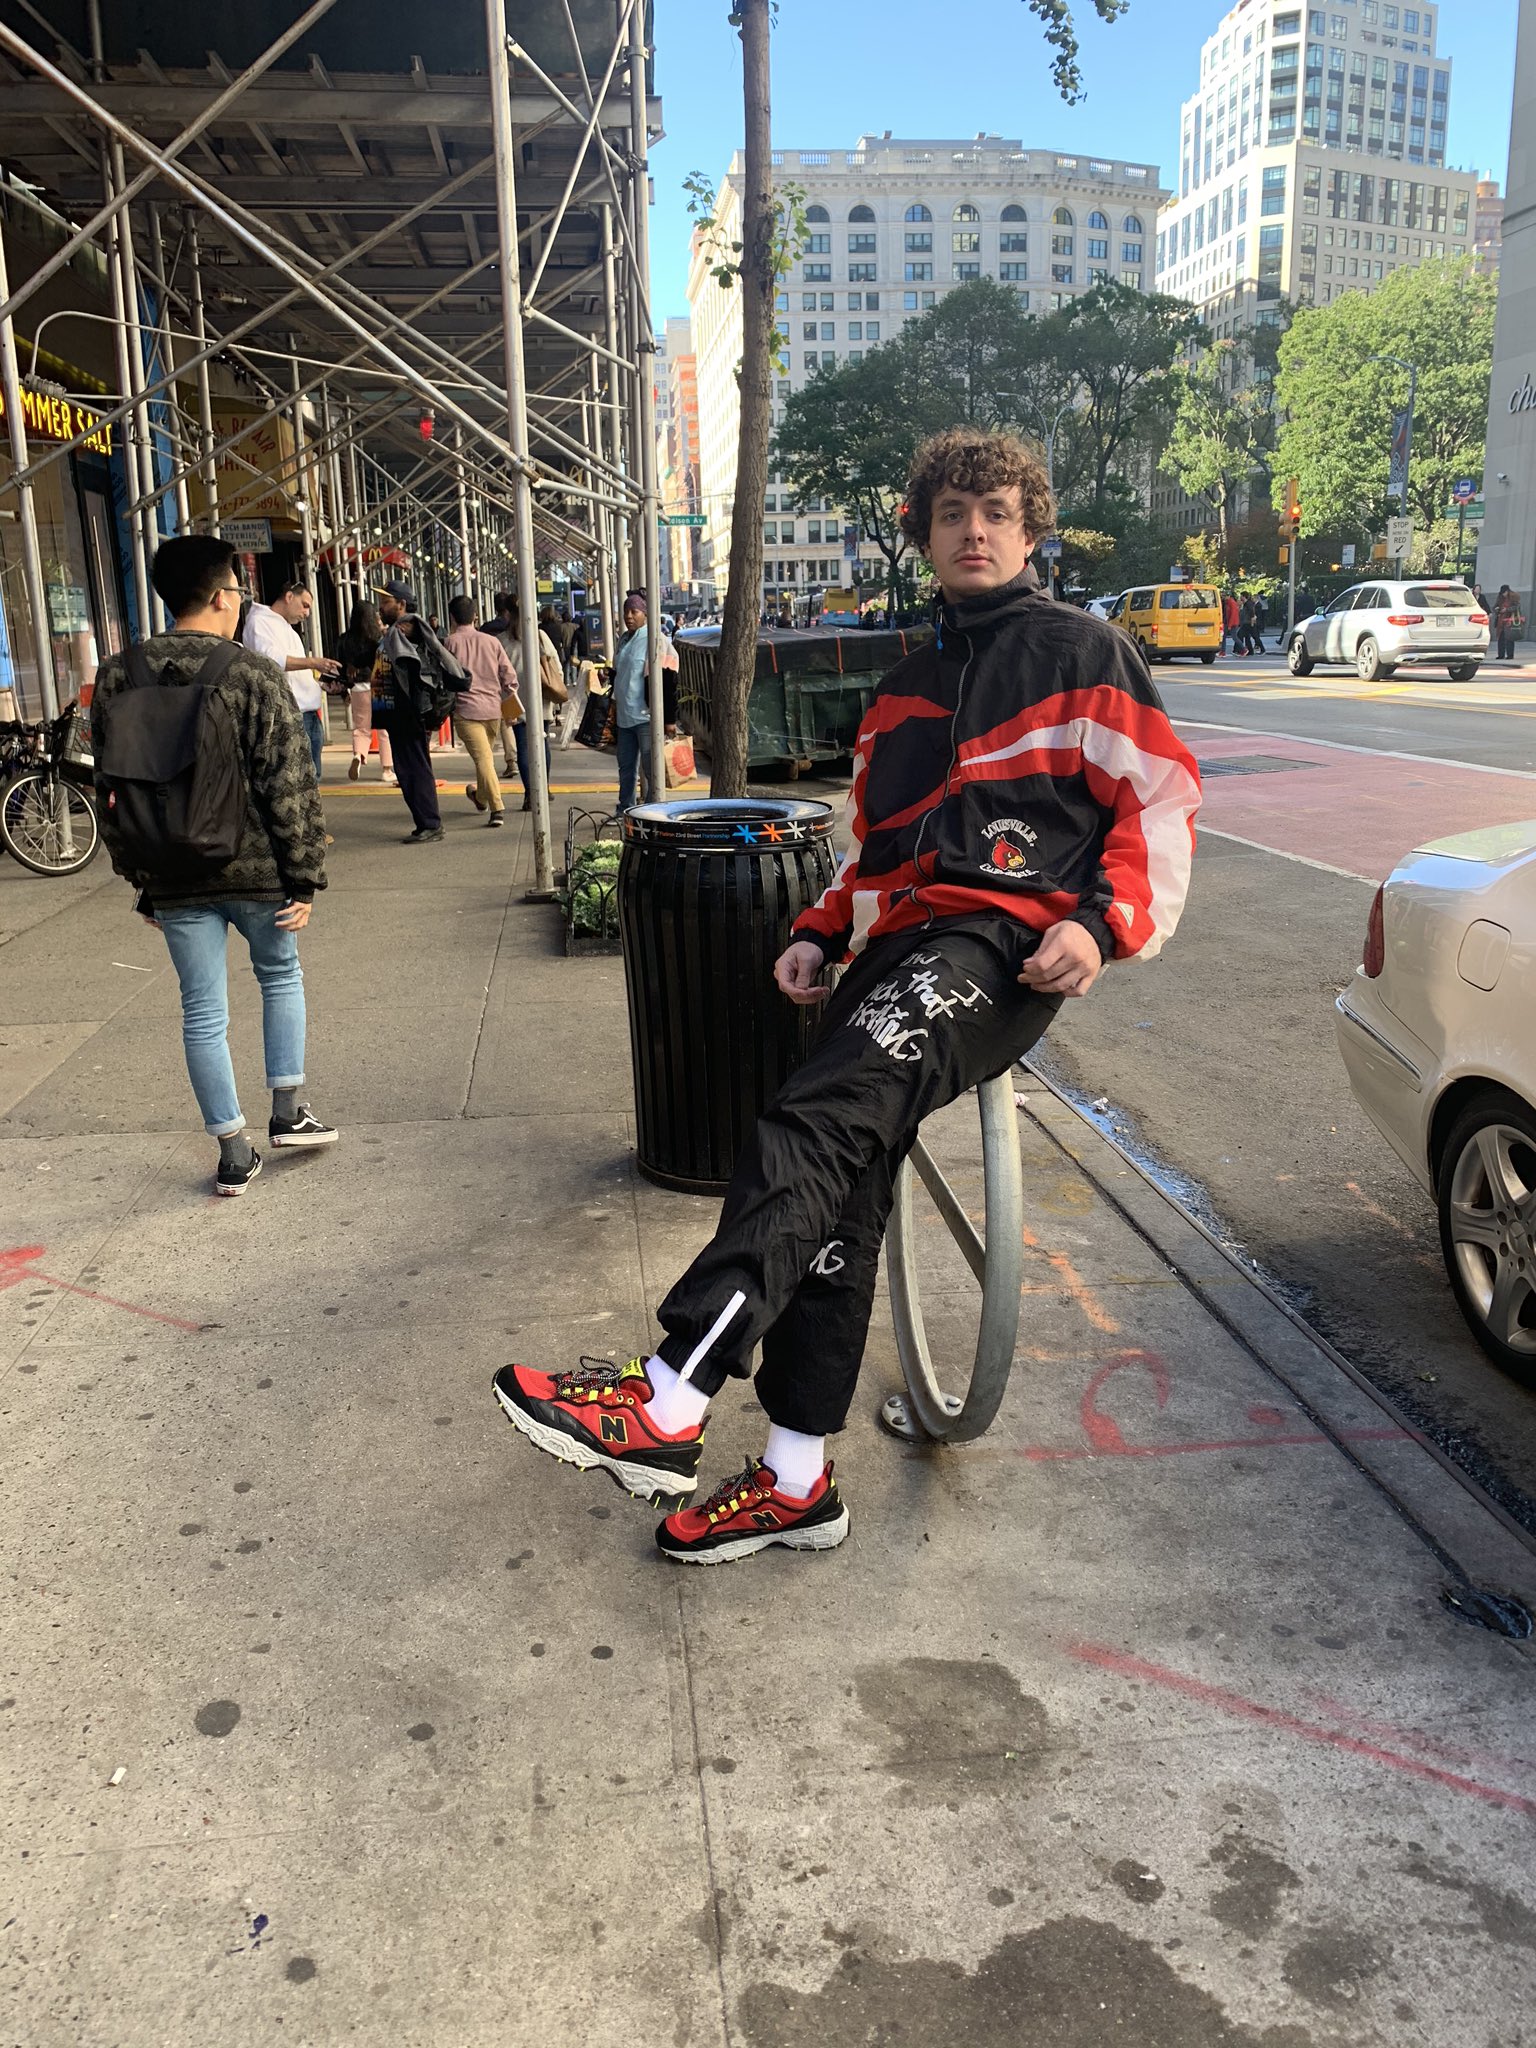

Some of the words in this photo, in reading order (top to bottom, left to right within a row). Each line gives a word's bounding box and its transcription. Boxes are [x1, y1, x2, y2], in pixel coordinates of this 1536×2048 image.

[0, 385, 73, 441] MMER
[661, 516, 690, 524] dison
[1393, 521, 1409, 529] STOP
[981, 818, 1038, 843] LOUISVILLE
[599, 1413, 628, 1444] N
[749, 1509, 781, 1530] N
